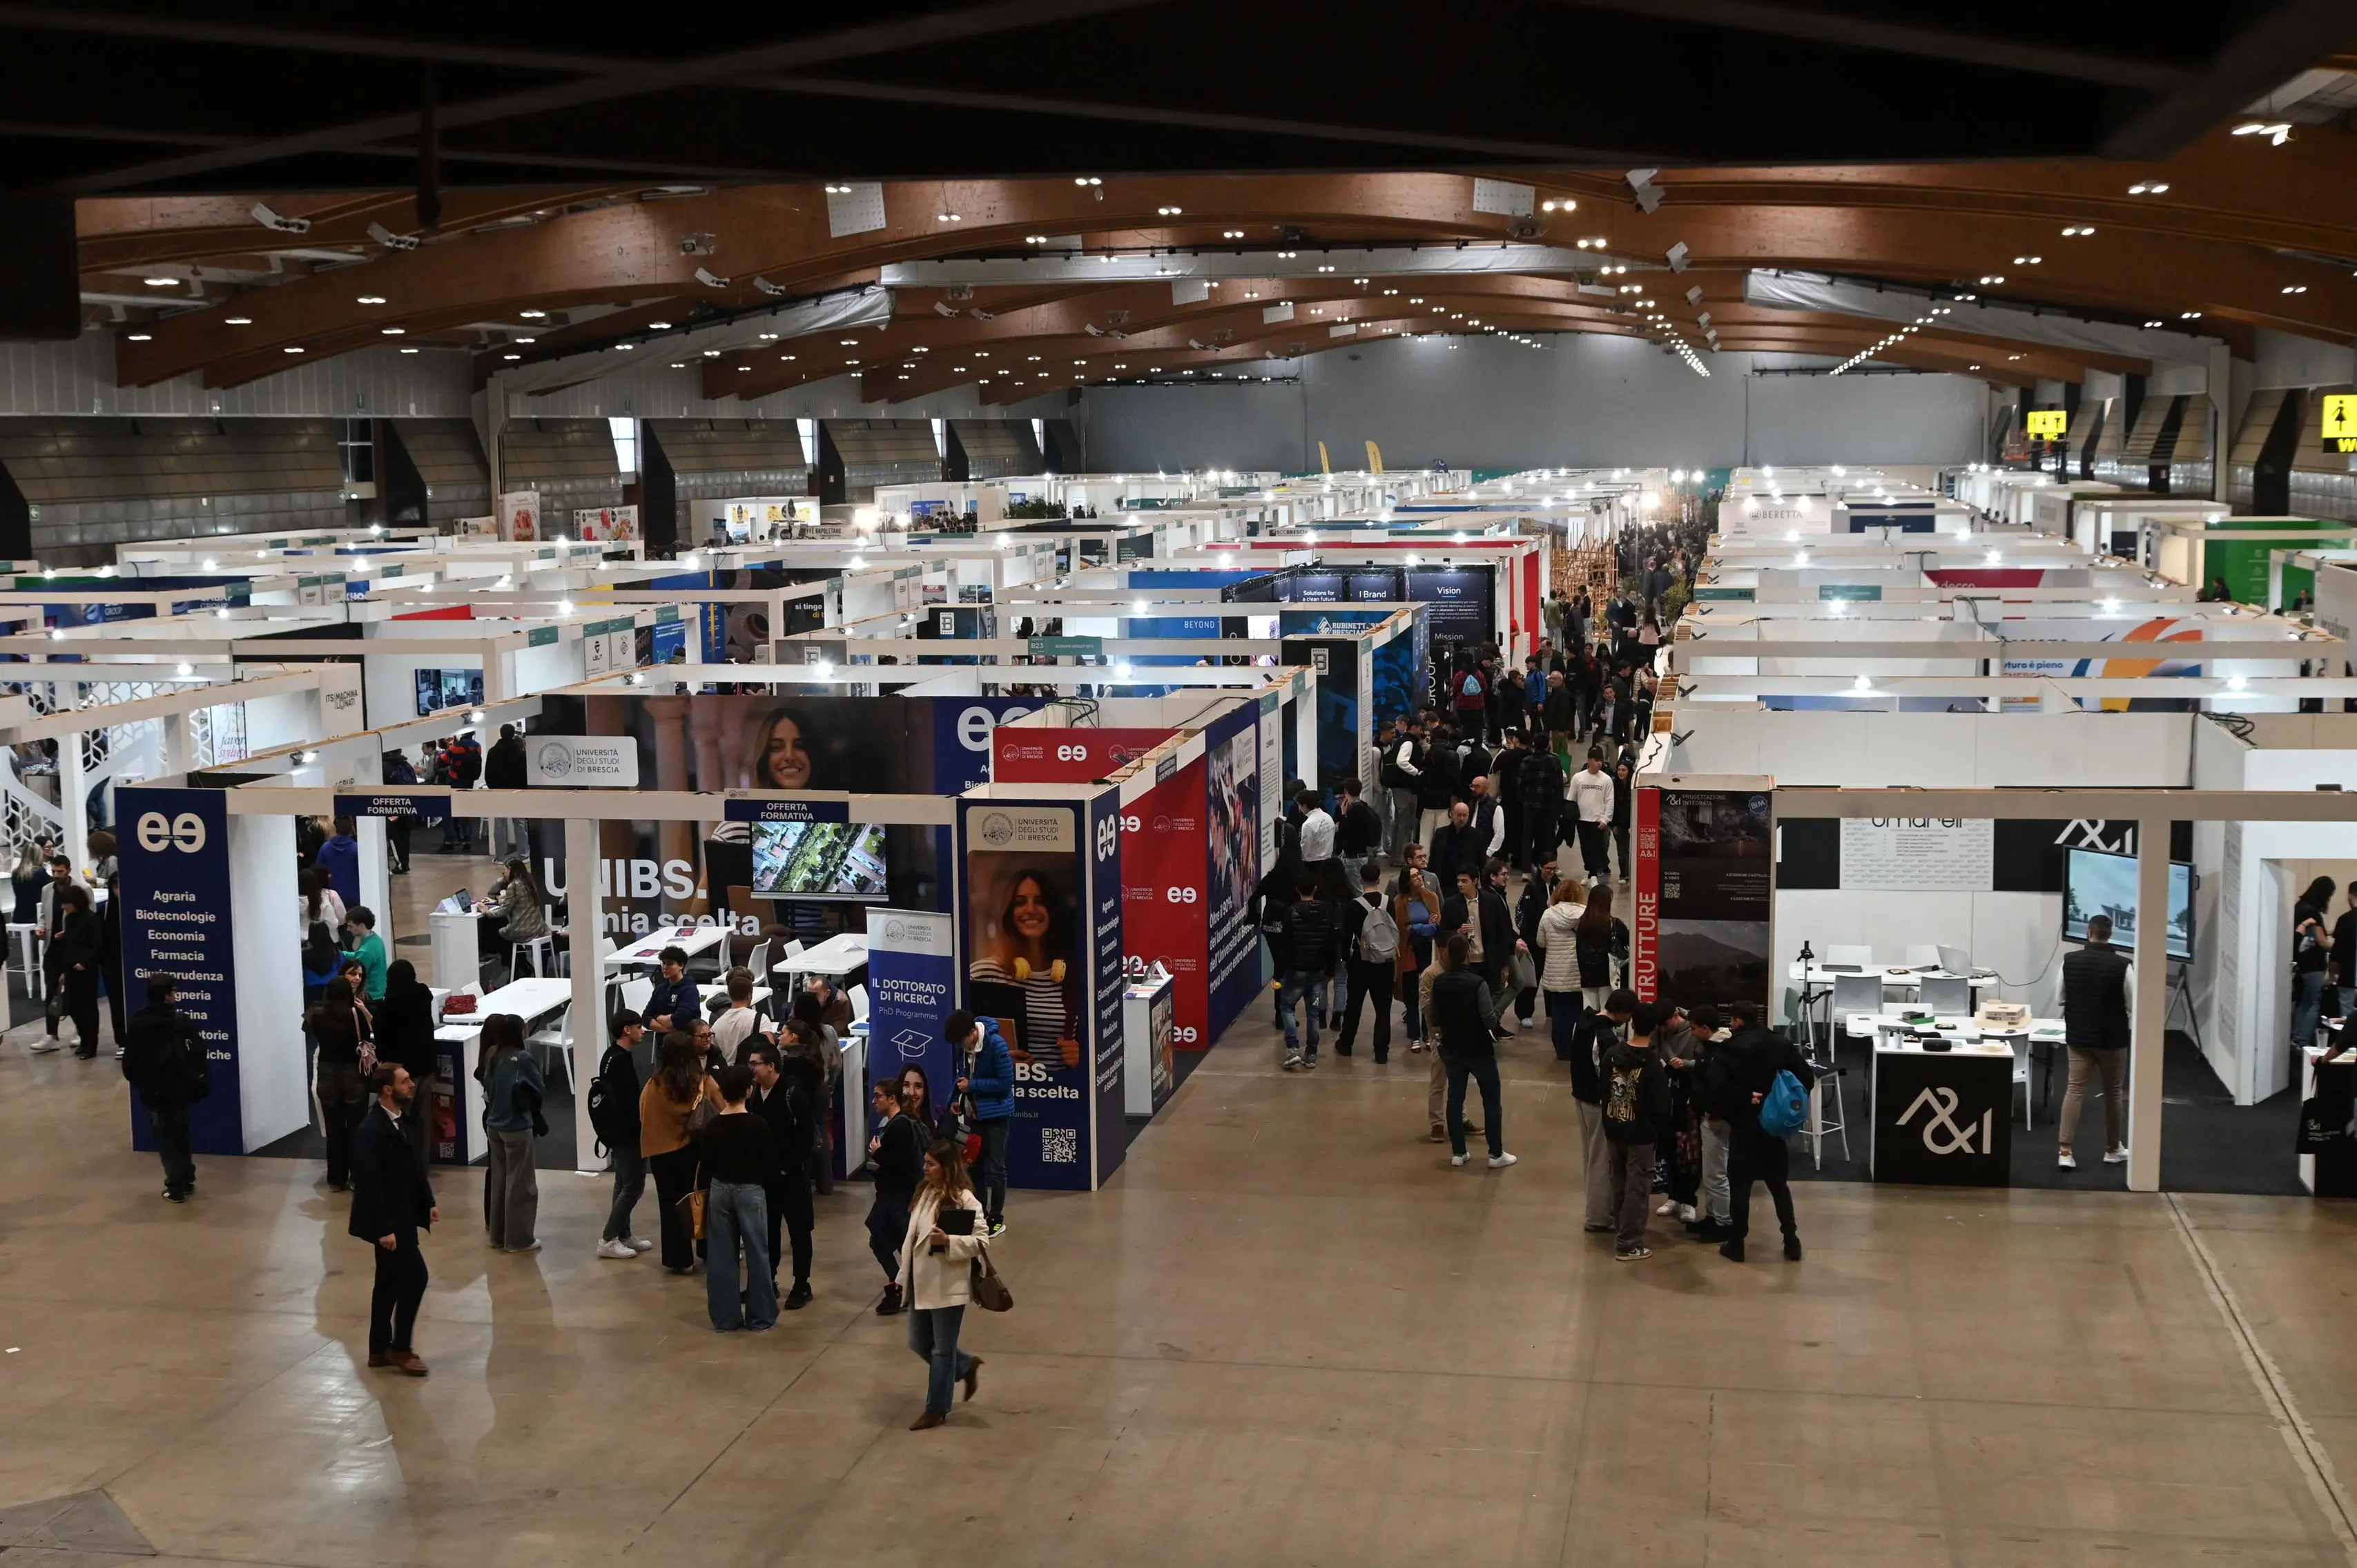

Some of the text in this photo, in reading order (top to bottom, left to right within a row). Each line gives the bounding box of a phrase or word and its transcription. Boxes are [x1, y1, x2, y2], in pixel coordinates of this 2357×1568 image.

[1763, 510, 1803, 519] BERETTA
[1364, 590, 1386, 599] Brand
[1437, 586, 1461, 594] Vision
[804, 603, 822, 612] tinge
[1184, 621, 1215, 629] BEYOND
[2029, 659, 2035, 668] è
[2037, 660, 2064, 670] pieno
[325, 689, 358, 703] ITS MACHINA
[576, 748, 619, 756] UNIVERSITÀ
[373, 797, 411, 806] OFFERTA
[766, 802, 808, 811] OFFERTA
[1751, 799, 1766, 810] BIM
[367, 806, 418, 815] FORMATIVA
[760, 812, 814, 820] FORMATIVA
[153, 890, 196, 903] Agraria
[1102, 896, 1114, 914] Agraria
[135, 909, 217, 924] Biotecnologie
[1210, 910, 1220, 929] Oltre
[1223, 895, 1232, 916] 90%
[1098, 914, 1119, 938] Biotecnologie
[1216, 916, 1232, 945] laureati
[148, 929, 205, 942] Economia
[1102, 936, 1117, 956] Economia
[1638, 892, 1656, 1005] TRUTTURE
[151, 949, 205, 961] Farmacia
[1220, 961, 1232, 983] lavoro
[1232, 949, 1243, 969] entro
[1243, 944, 1248, 958] un
[1248, 934, 1257, 952] anno
[1103, 956, 1117, 977] Farmacia
[873, 978, 946, 994] IL DOTTORATO
[174, 989, 211, 1001] gneria
[880, 991, 937, 1006] DI RICERCA
[879, 1007, 938, 1020] PhD Programmes
[1101, 998, 1118, 1019] Ingegneria
[1103, 1020, 1118, 1039] Medicina
[1028, 1085, 1079, 1099] scelta
[1896, 1087, 1992, 1155] A&I
